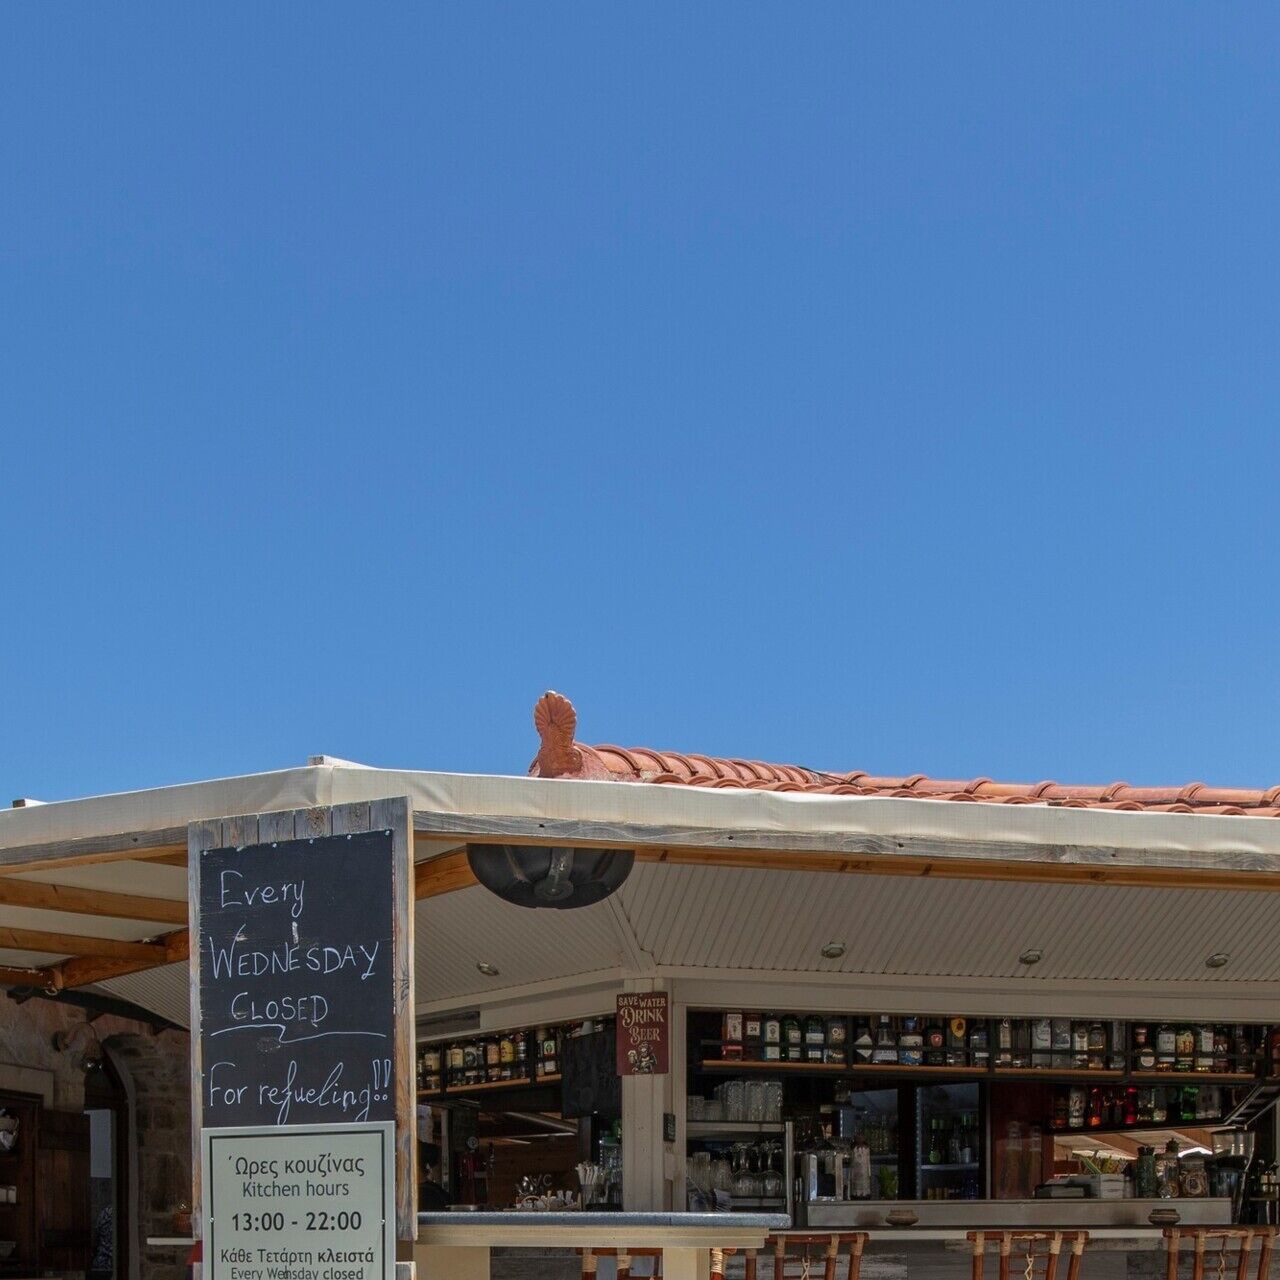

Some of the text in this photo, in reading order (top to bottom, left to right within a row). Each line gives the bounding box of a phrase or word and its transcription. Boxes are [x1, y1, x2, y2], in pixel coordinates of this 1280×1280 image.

[220, 870, 305, 918] Every
[209, 924, 379, 981] WEDNESDAY
[231, 991, 329, 1027] CLOSED
[618, 996, 666, 1008] SAVE WATER
[620, 1006, 665, 1028] DRINK
[629, 1026, 661, 1045] BEER
[210, 1061, 248, 1107] For
[285, 1153, 365, 1177] κουζίνας
[242, 1180, 349, 1197] Kitchen hours
[232, 1212, 284, 1231] 13:00
[305, 1211, 362, 1231] 22:00
[221, 1247, 374, 1267] Κάθε Τετάρτη κλειστά
[323, 1266, 364, 1280] closed
